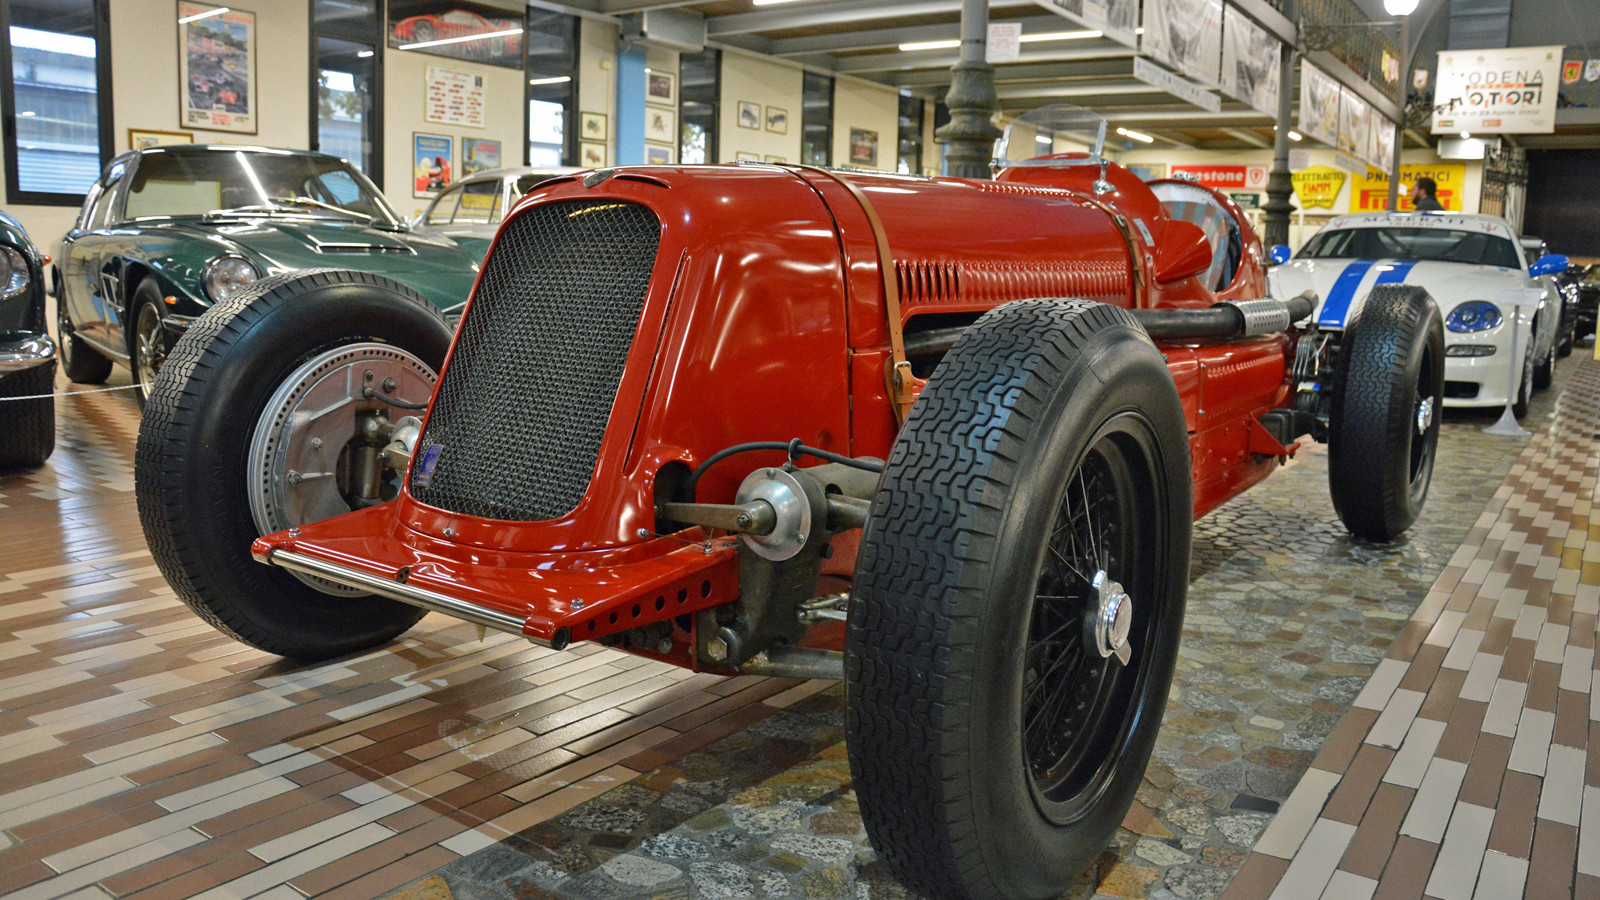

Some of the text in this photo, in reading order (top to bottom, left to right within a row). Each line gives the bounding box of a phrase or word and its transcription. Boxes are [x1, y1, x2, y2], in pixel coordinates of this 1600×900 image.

[1452, 69, 1544, 84] ODENA
[1173, 170, 1244, 182] estone
[1366, 171, 1450, 181] PNEMATICI
[1303, 183, 1331, 193] FIAMM
[1363, 216, 1465, 225] MASERATI
